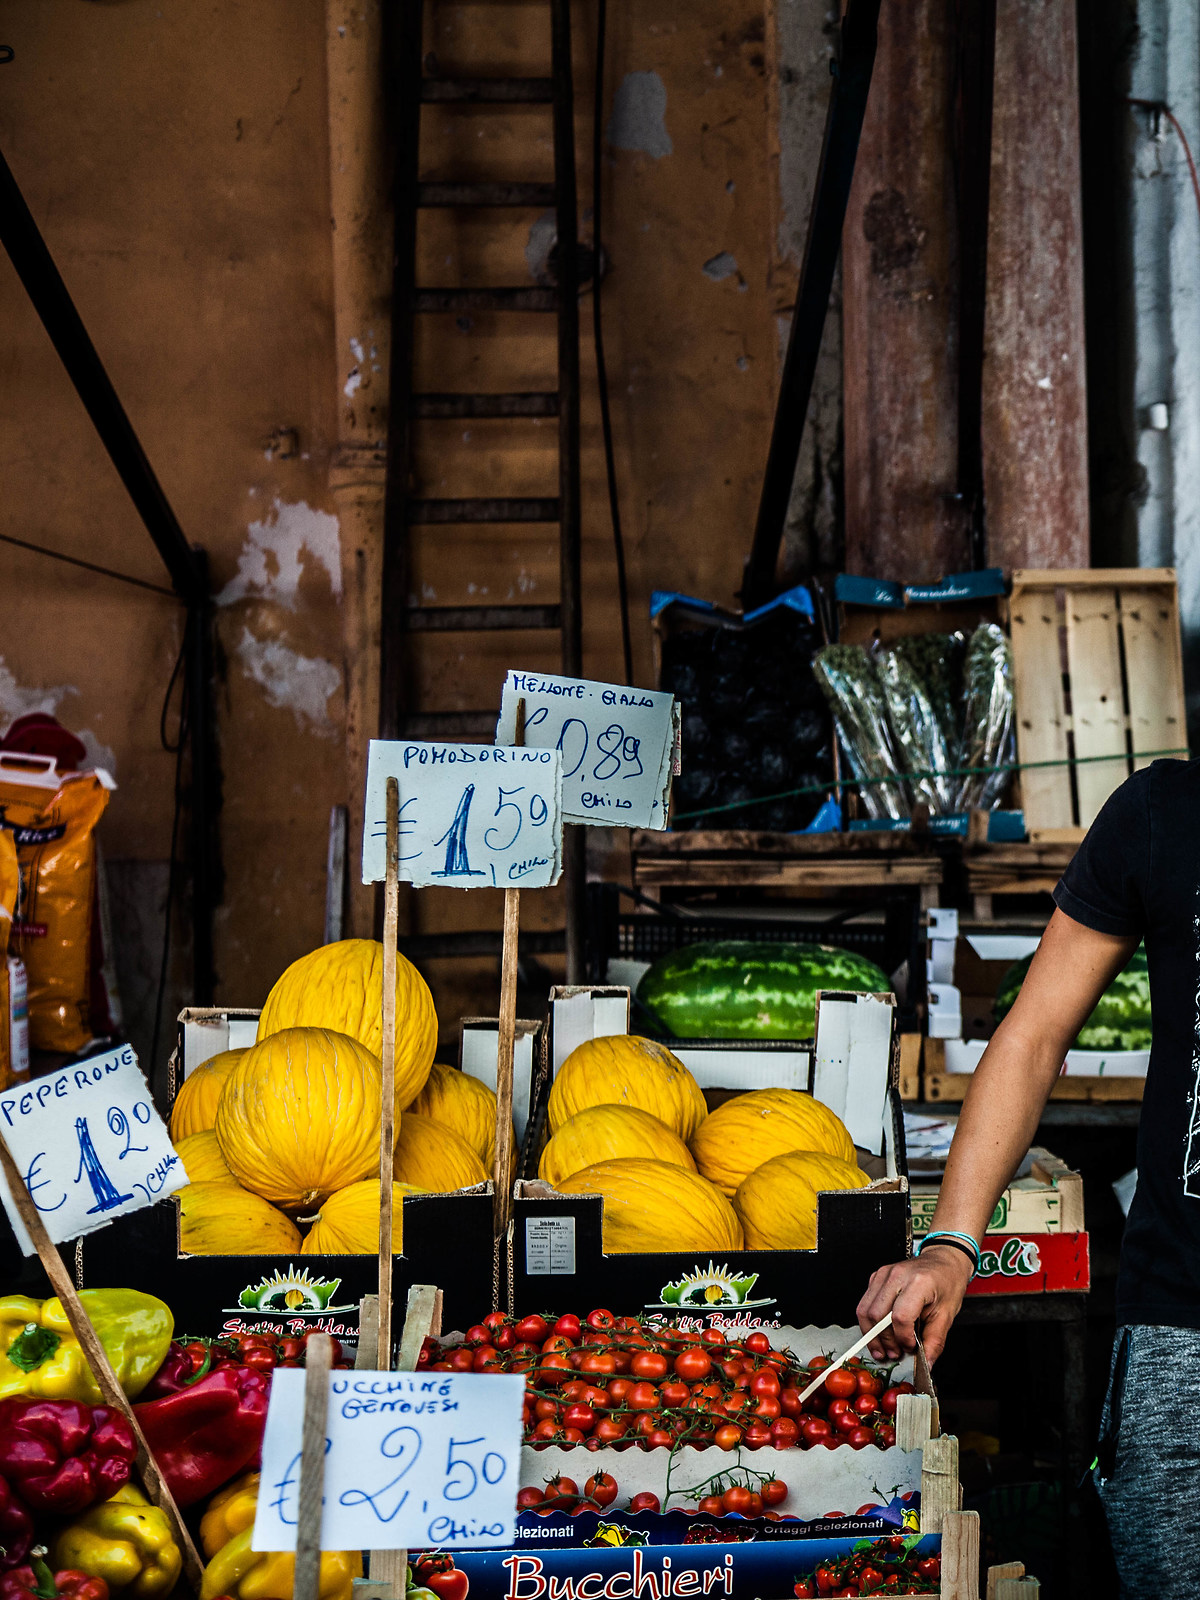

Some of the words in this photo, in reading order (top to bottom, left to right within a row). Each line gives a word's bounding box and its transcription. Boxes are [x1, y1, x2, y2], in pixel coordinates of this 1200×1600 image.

[601, 689, 654, 708] GIALLO
[403, 745, 551, 768] POMODORINO
[556, 718, 644, 781] 0,89
[0, 1048, 134, 1127] PEPERONE
[706, 1311, 761, 1329] Bedda
[331, 1377, 455, 1397] UCCHiNE
[513, 1524, 575, 1539] elezionati
[763, 1524, 811, 1537] Ortaggi
[814, 1517, 885, 1533] Selezionati
[501, 1548, 734, 1600] Bucchieri
